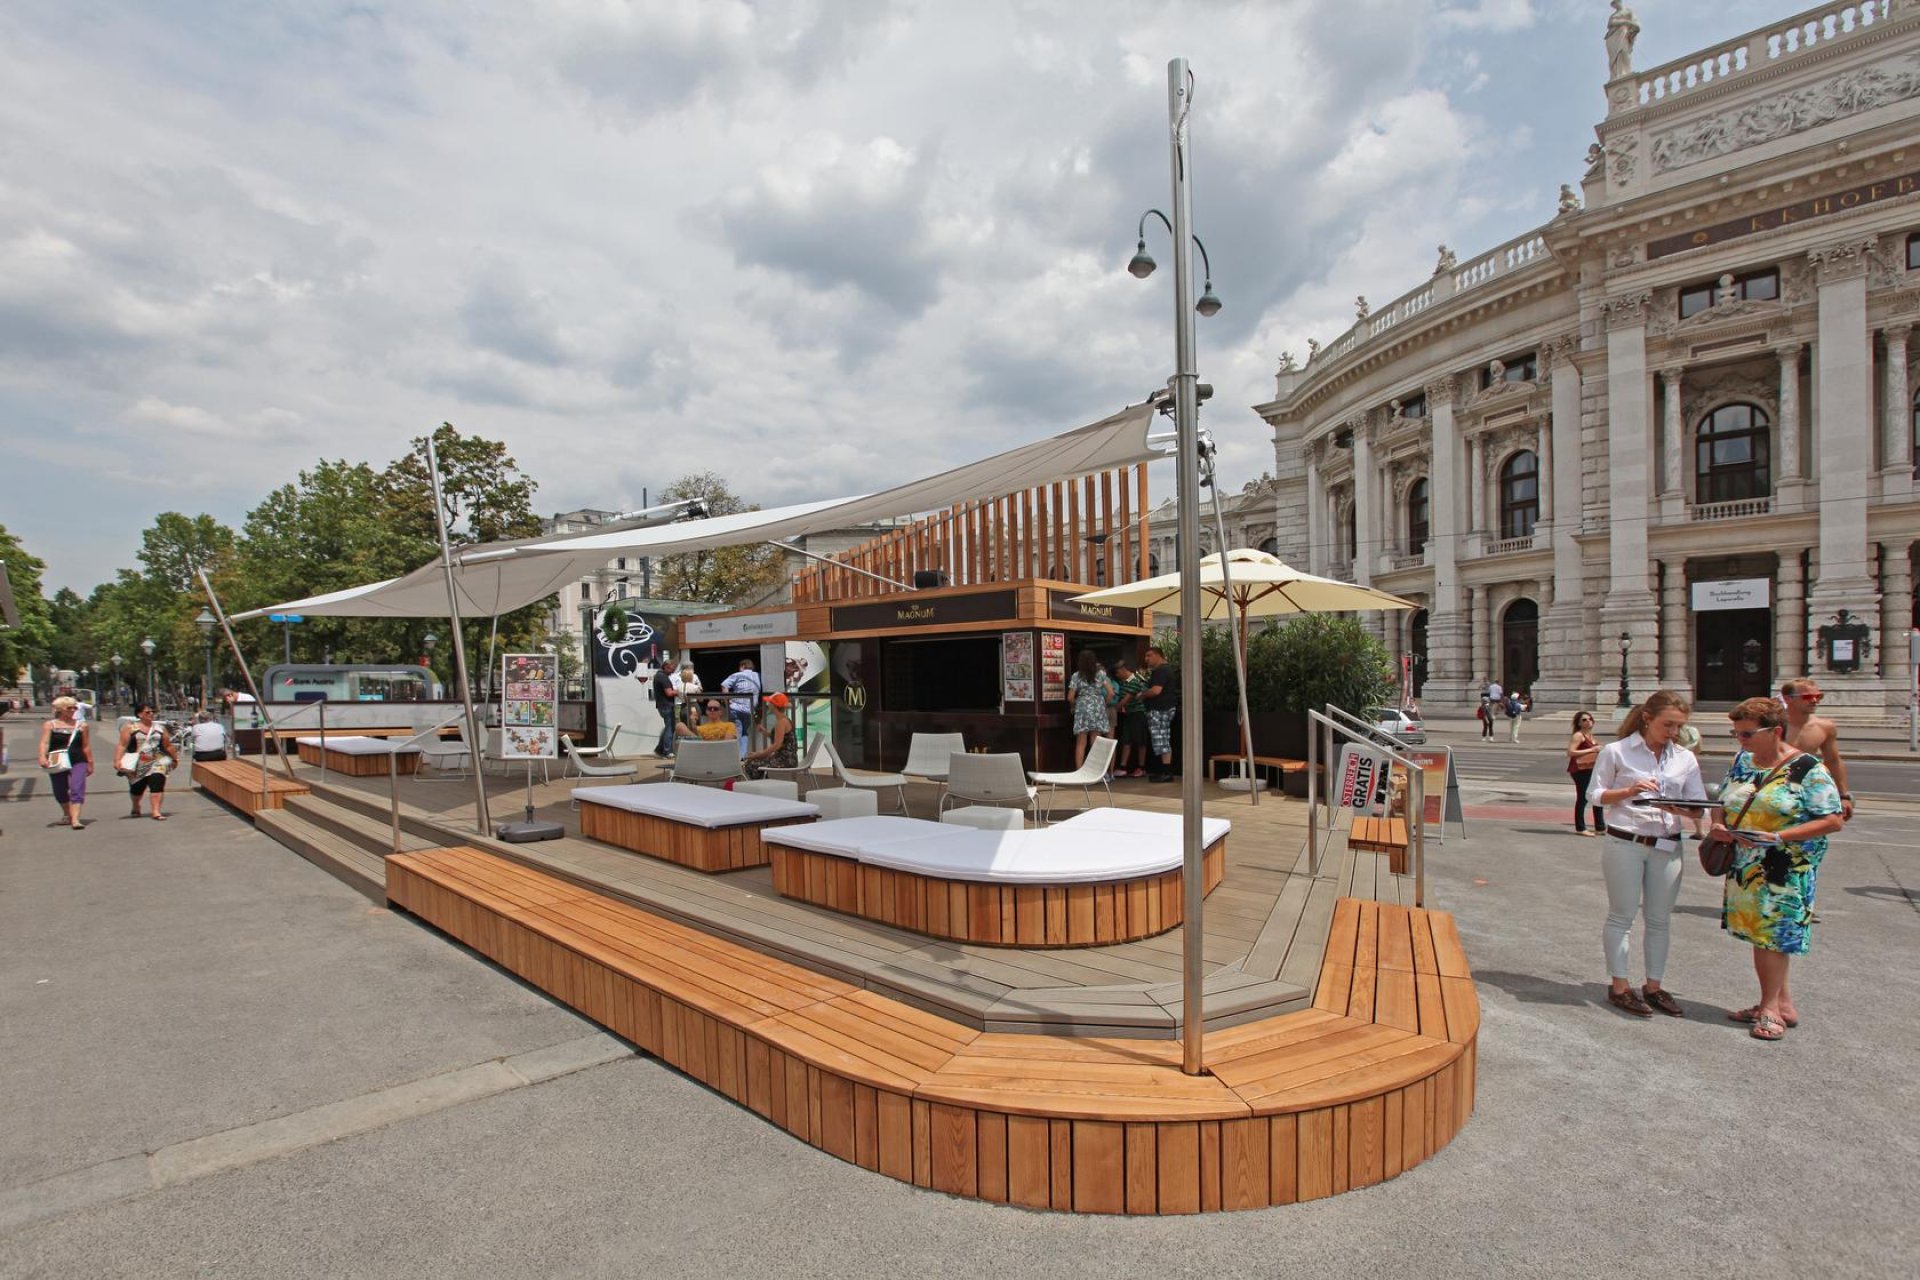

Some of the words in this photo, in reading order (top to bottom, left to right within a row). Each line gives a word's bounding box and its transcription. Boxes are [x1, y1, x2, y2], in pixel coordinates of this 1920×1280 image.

[1783, 208, 1798, 223] K
[1814, 177, 1915, 215] HOFB
[897, 607, 935, 620] MAGNUM
[1080, 603, 1112, 617] MAGNUM
[847, 686, 864, 706] M
[1352, 757, 1373, 809] GRATIS
